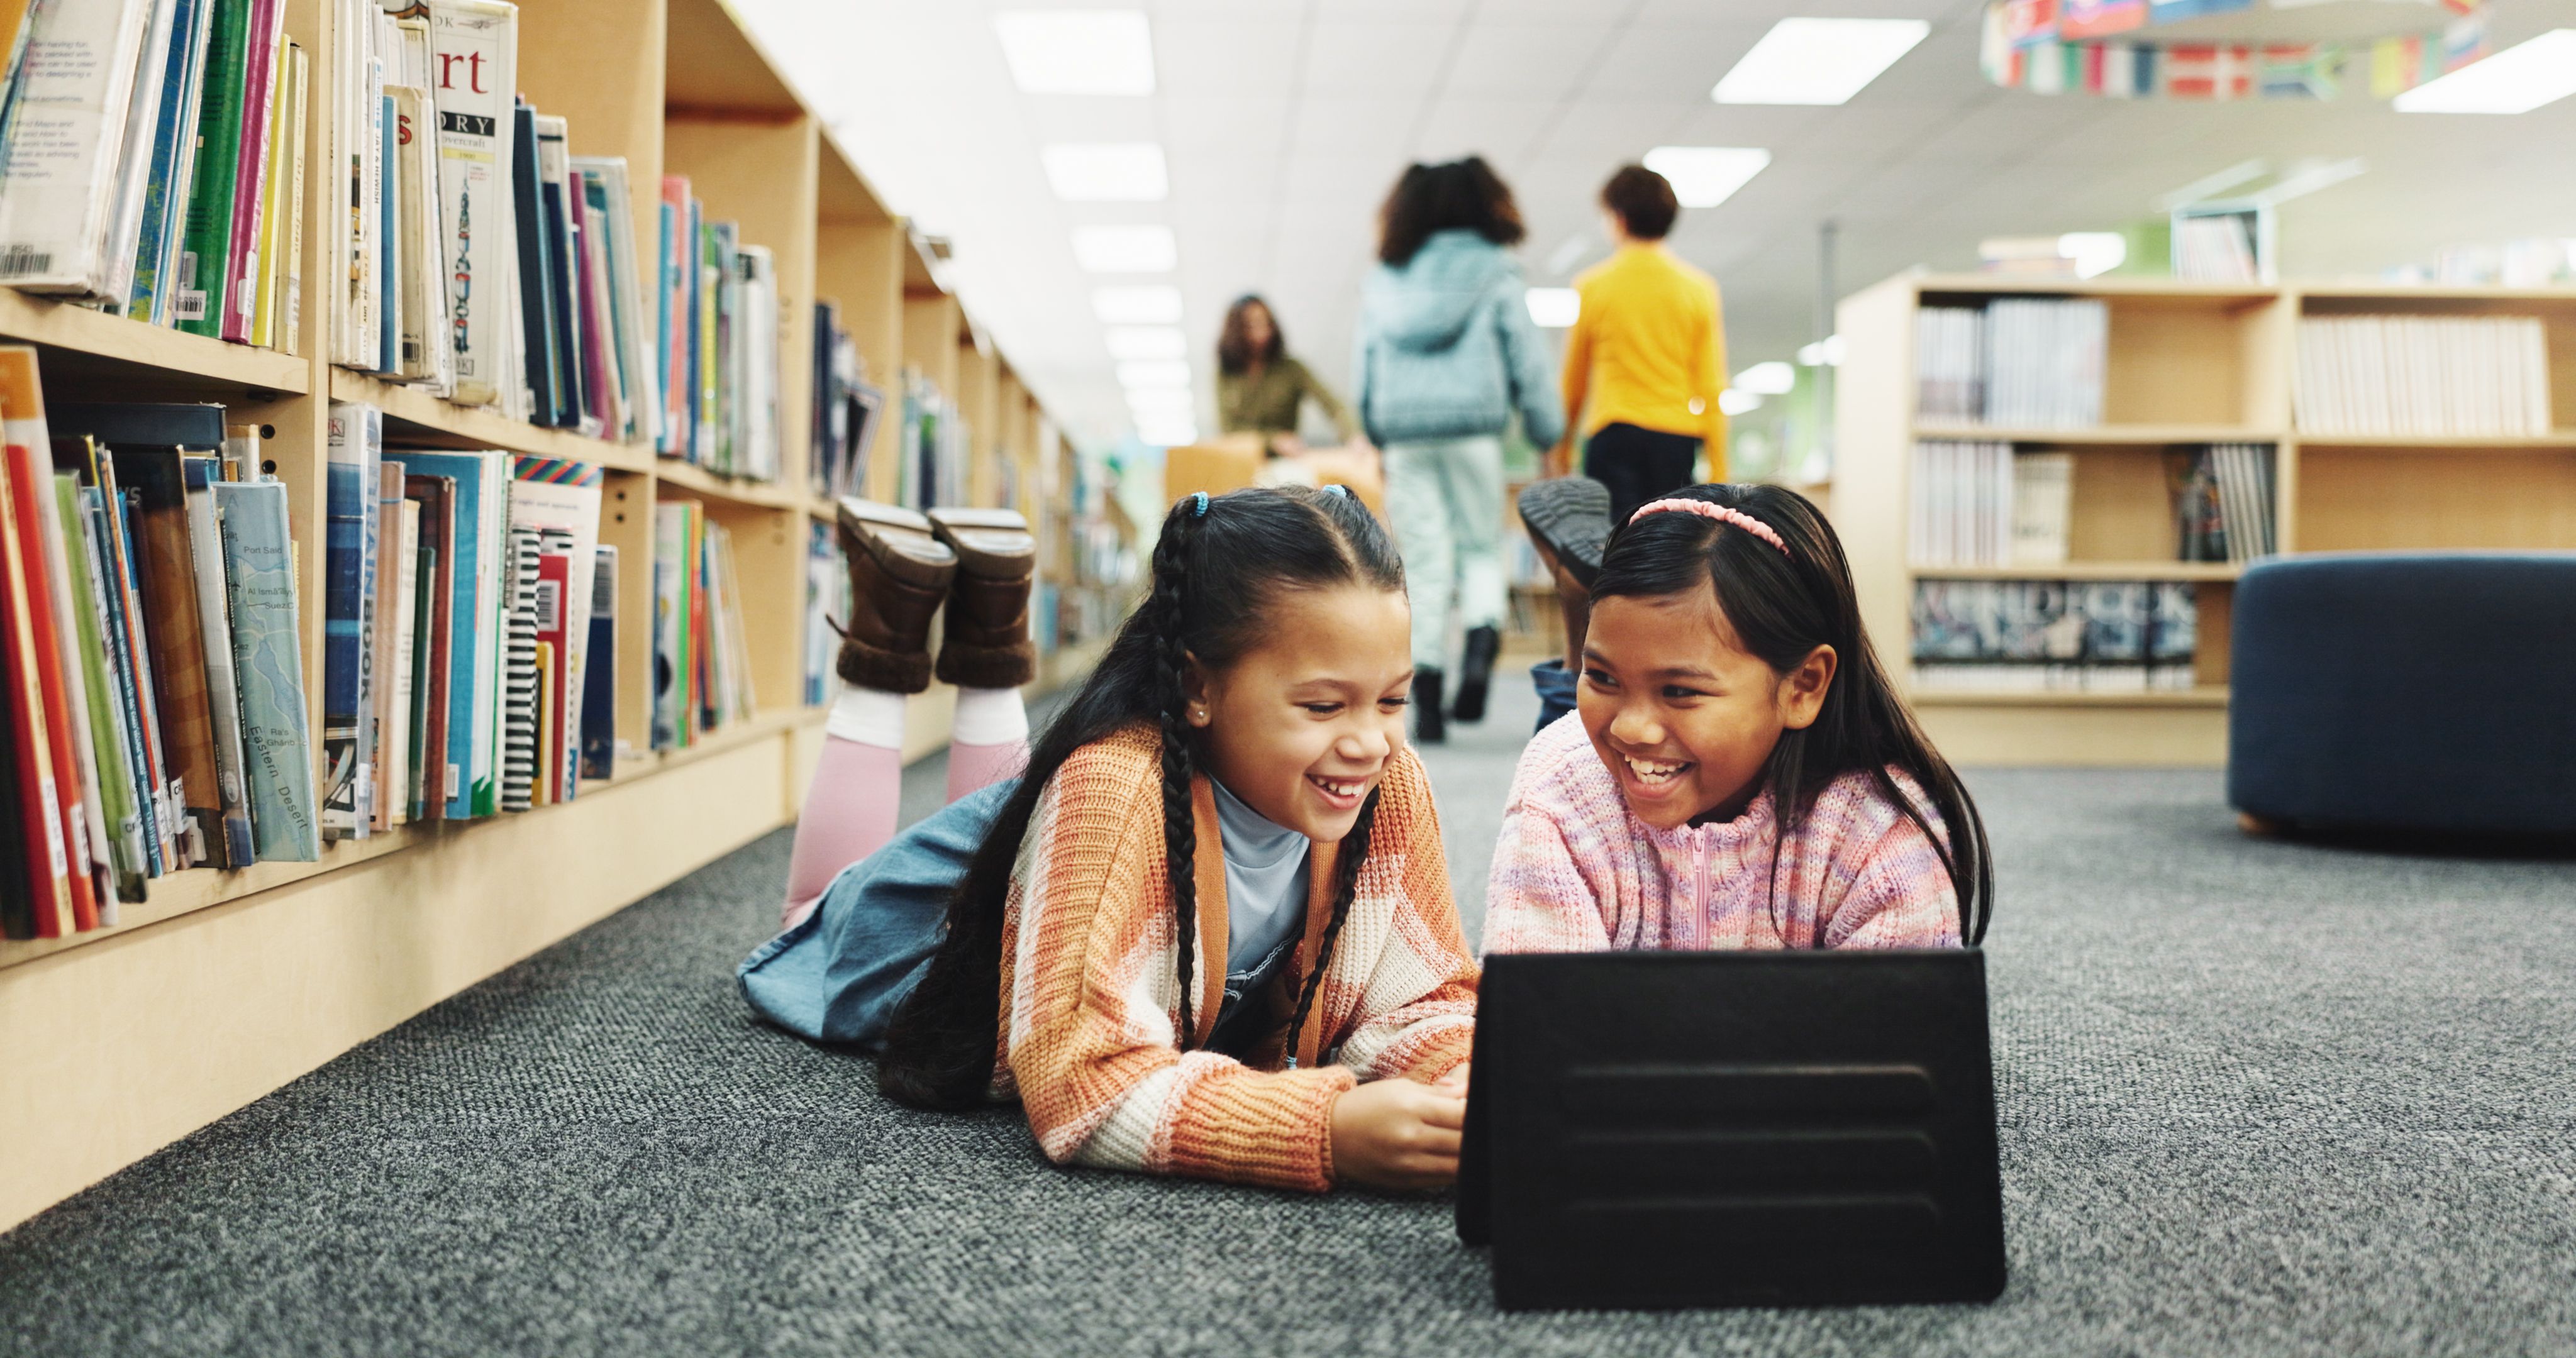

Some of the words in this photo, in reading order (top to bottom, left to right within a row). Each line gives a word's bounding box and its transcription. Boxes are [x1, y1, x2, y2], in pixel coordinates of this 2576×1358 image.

[438, 50, 489, 94] rt
[243, 546, 262, 554] Port
[263, 546, 283, 555] Said
[264, 601, 286, 610] Suez
[361, 599, 374, 701] BOOK
[250, 726, 279, 778] Eastern
[278, 786, 308, 829] Desert
